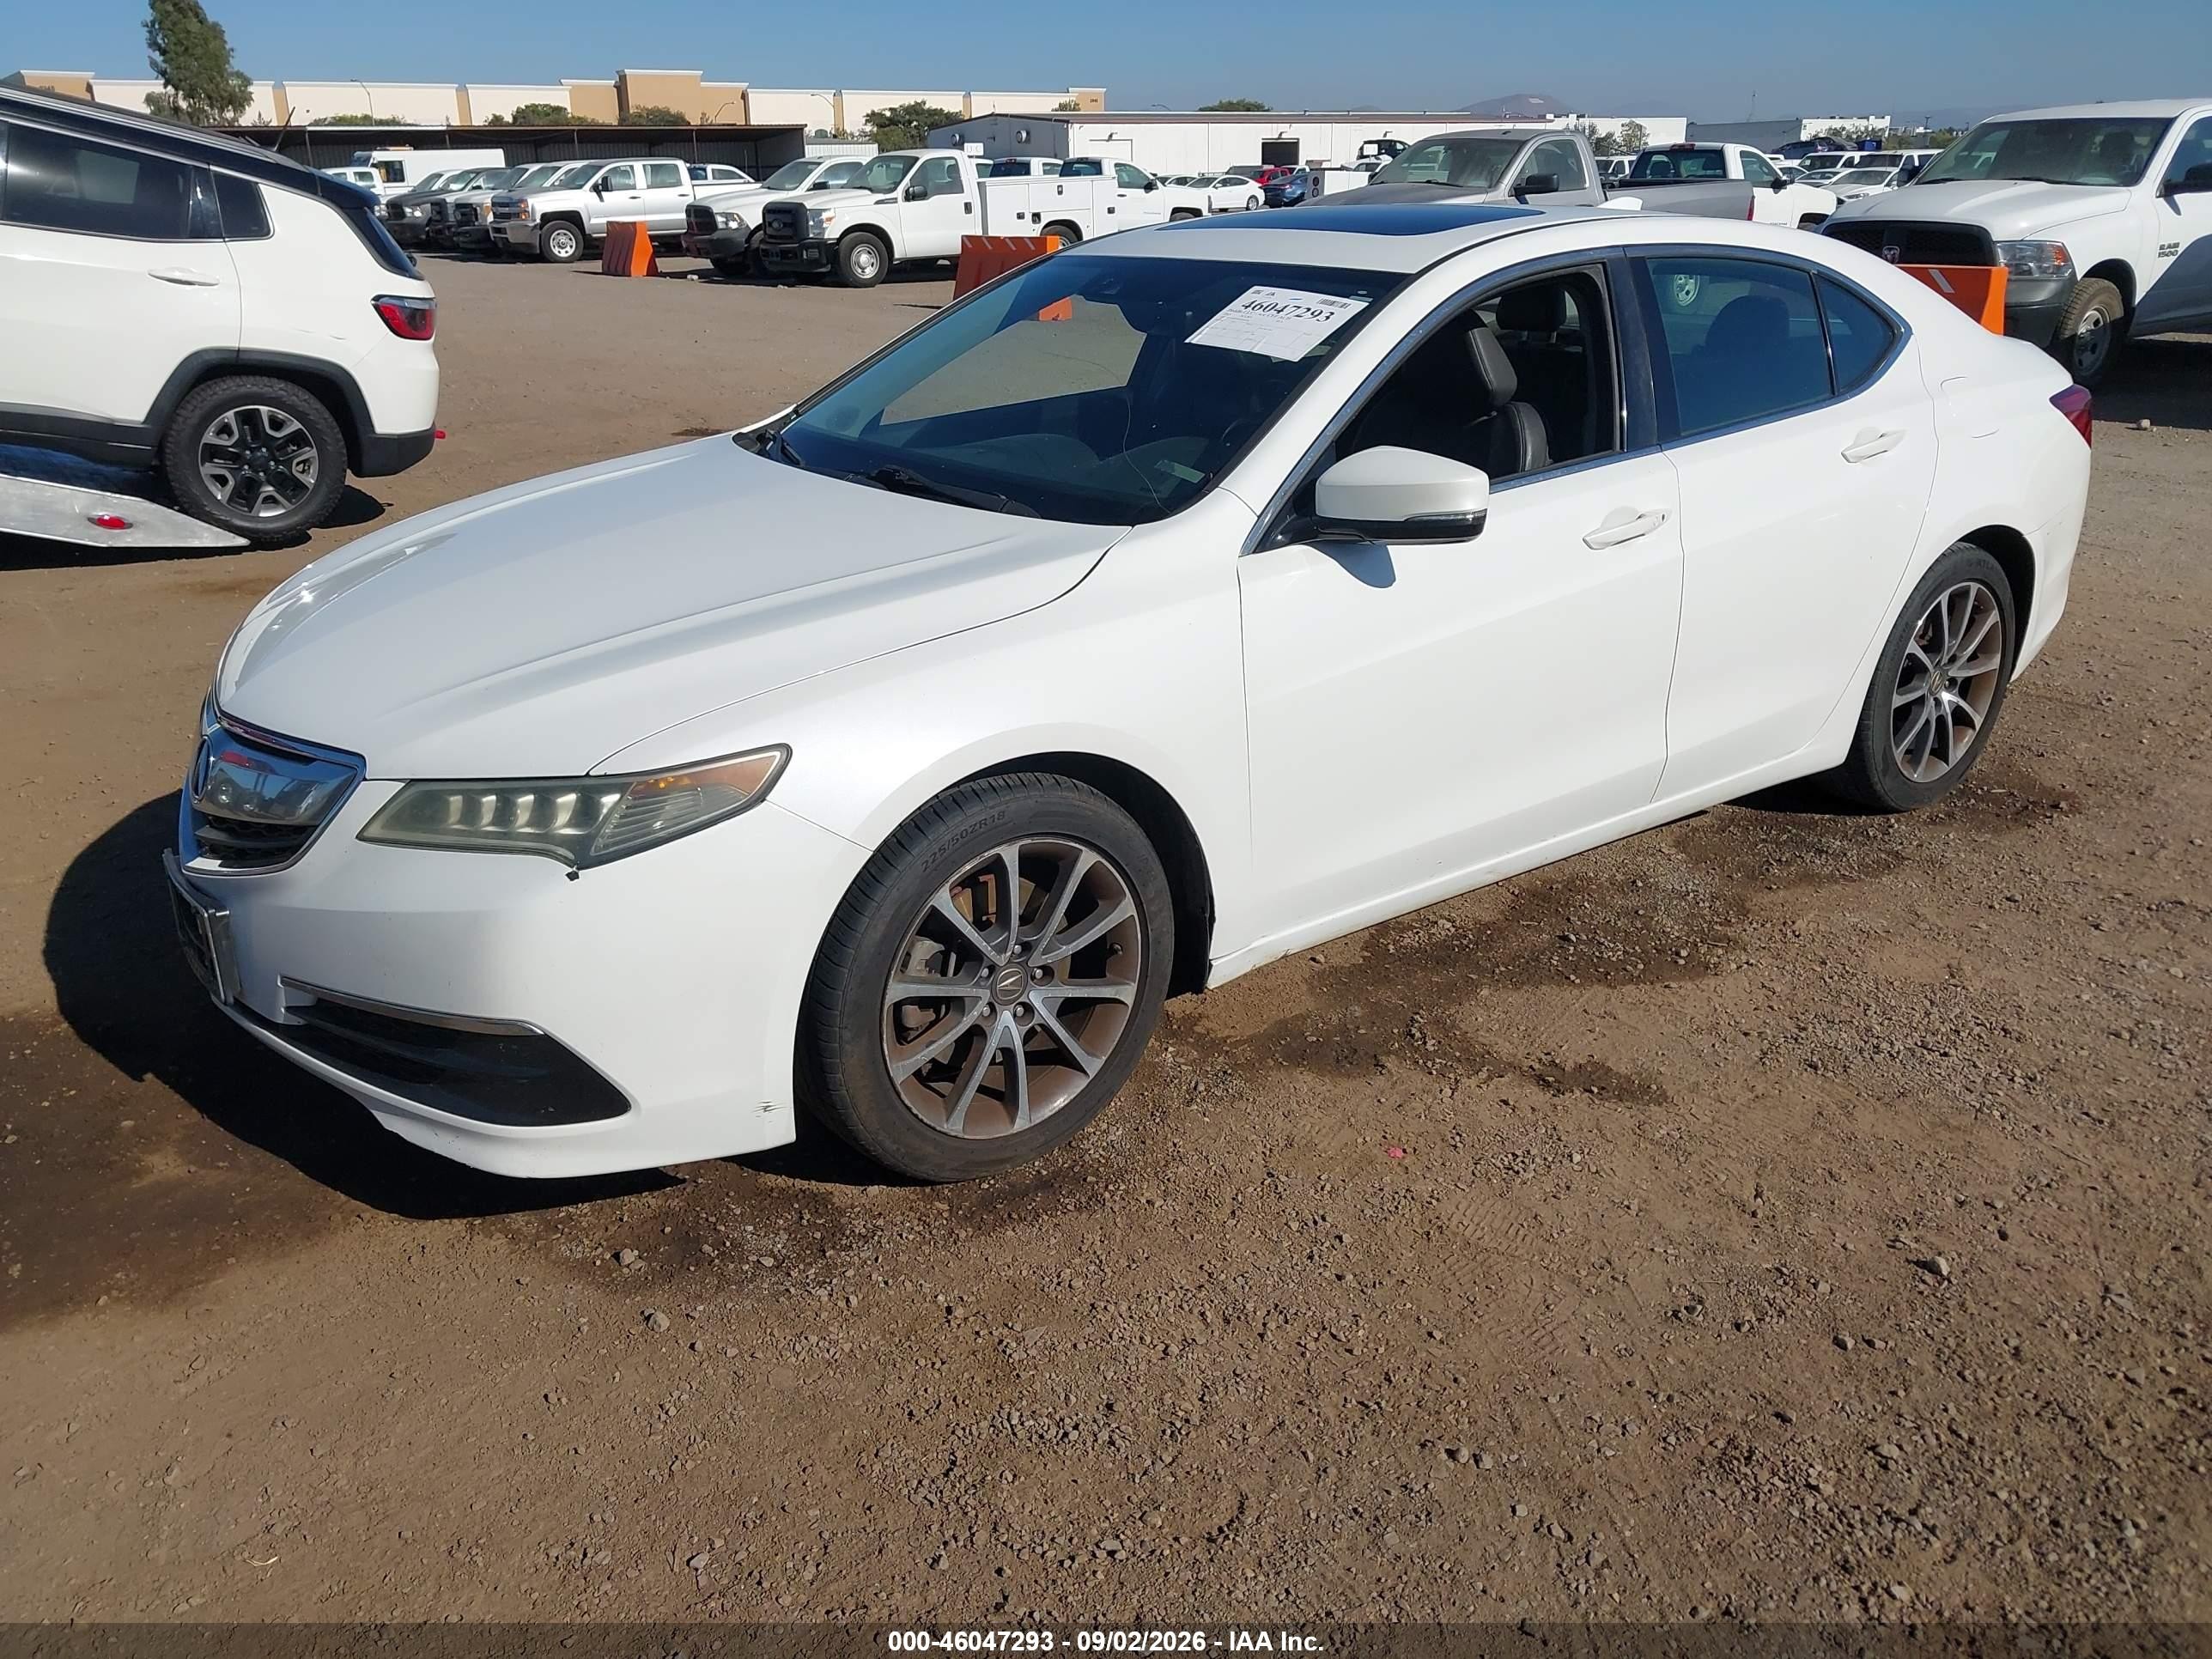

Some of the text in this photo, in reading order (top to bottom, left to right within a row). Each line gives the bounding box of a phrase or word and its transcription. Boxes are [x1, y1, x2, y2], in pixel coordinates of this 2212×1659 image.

[2157, 249, 2179, 258] 1500
[2158, 241, 2180, 250] RAM
[1241, 299, 1335, 322] 46047293
[921, 811, 1006, 873] 225/50ZR18
